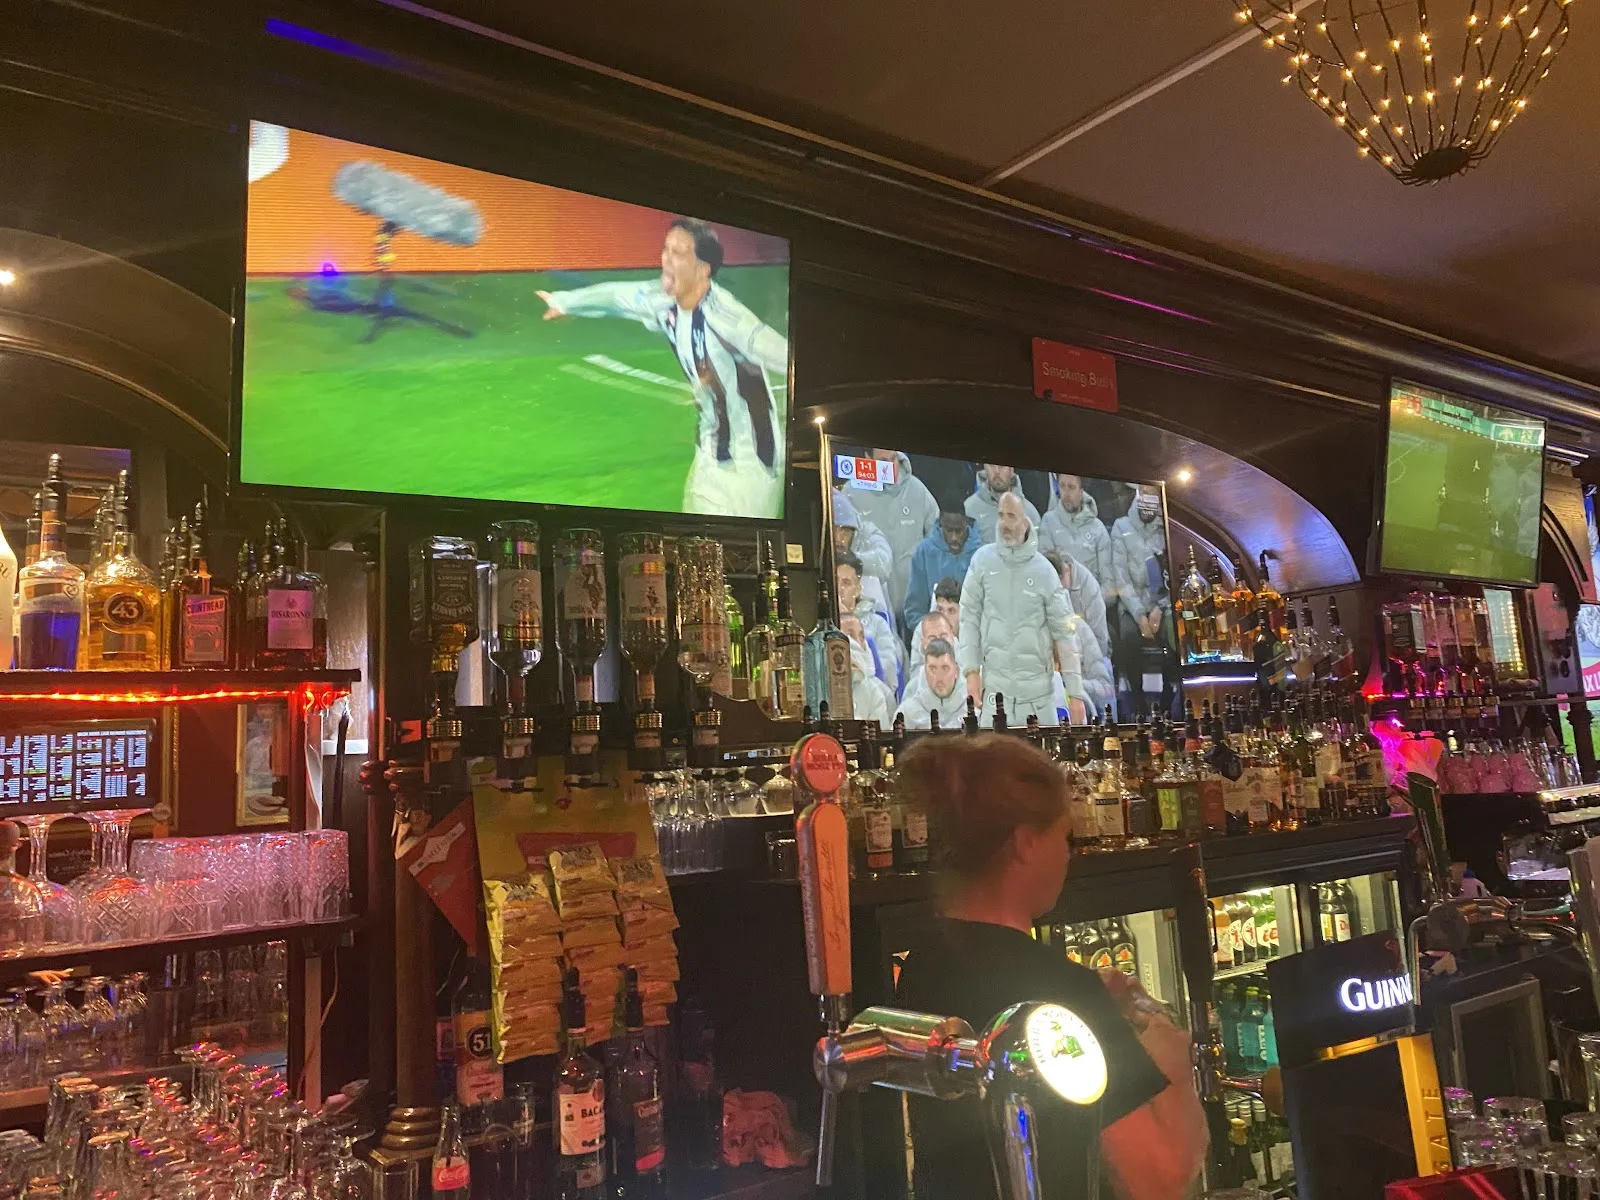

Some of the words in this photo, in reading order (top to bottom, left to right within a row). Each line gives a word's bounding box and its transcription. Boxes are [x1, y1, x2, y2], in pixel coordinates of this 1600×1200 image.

[1042, 361, 1087, 388] Smoking
[857, 471, 876, 479] 94:03
[859, 461, 873, 471] 1-1
[111, 600, 139, 619] 43
[473, 1033, 491, 1052] 51
